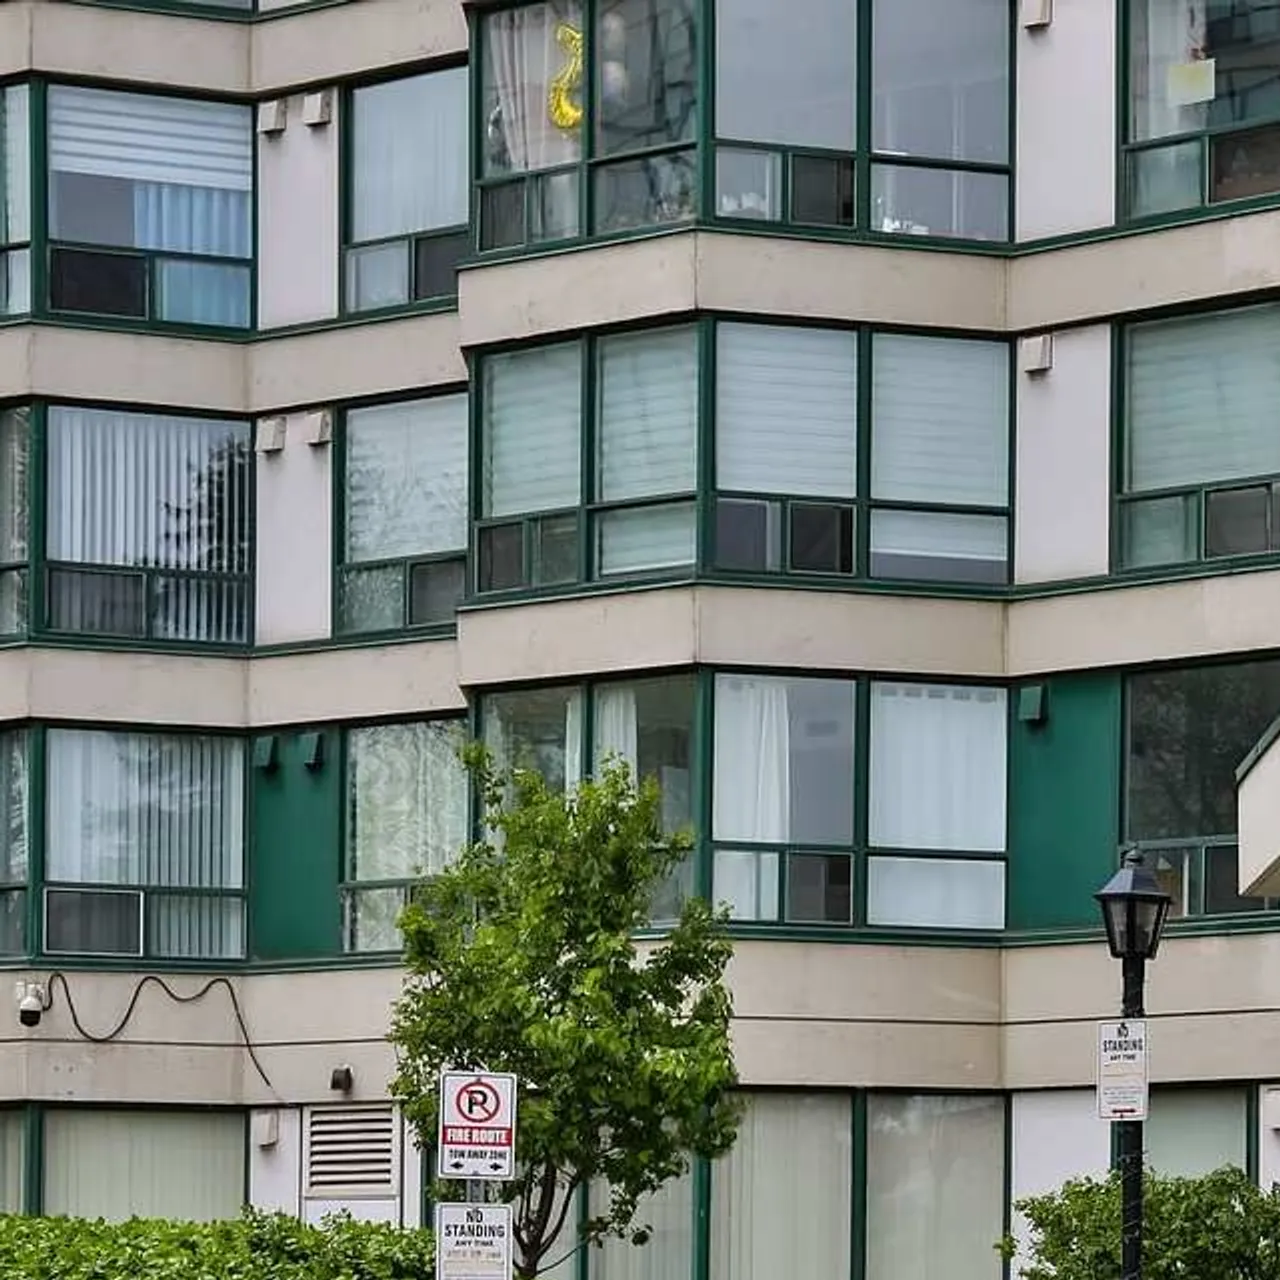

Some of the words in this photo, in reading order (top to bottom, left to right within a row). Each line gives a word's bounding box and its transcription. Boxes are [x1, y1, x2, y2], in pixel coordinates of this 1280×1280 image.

[1104, 1039, 1143, 1052] STANDING
[447, 1128, 471, 1143] FIRE
[472, 1128, 509, 1144] ROUTE
[466, 1209, 483, 1223] NO
[444, 1224, 505, 1238] STANDING
